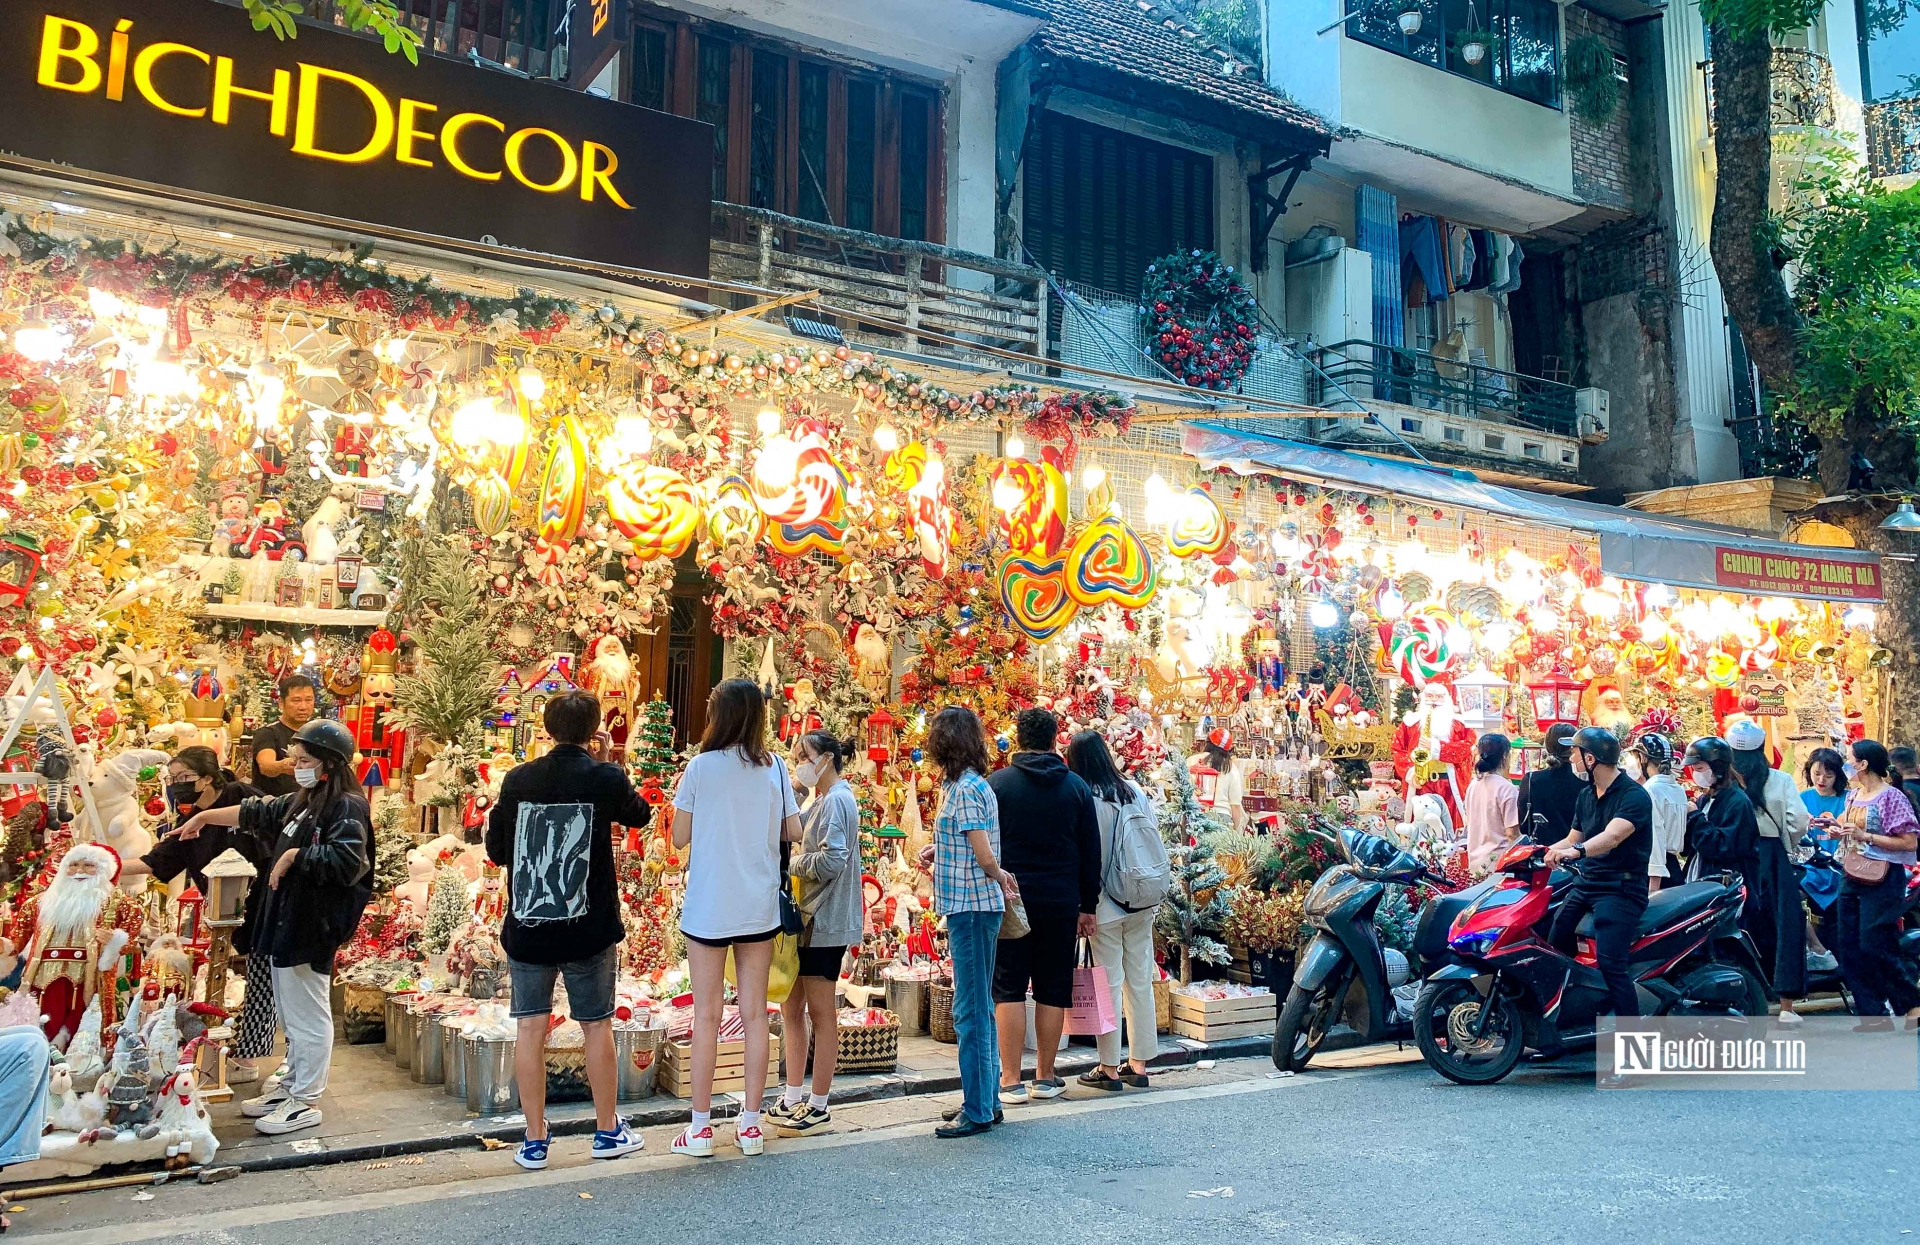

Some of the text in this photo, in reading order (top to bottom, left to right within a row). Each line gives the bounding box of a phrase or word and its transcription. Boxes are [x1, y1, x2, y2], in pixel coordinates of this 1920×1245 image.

[1765, 557, 1801, 580] CHÚC
[1803, 563, 1818, 582] 72
[1820, 561, 1854, 585] HÀNG
[1855, 565, 1876, 586] MÃ
